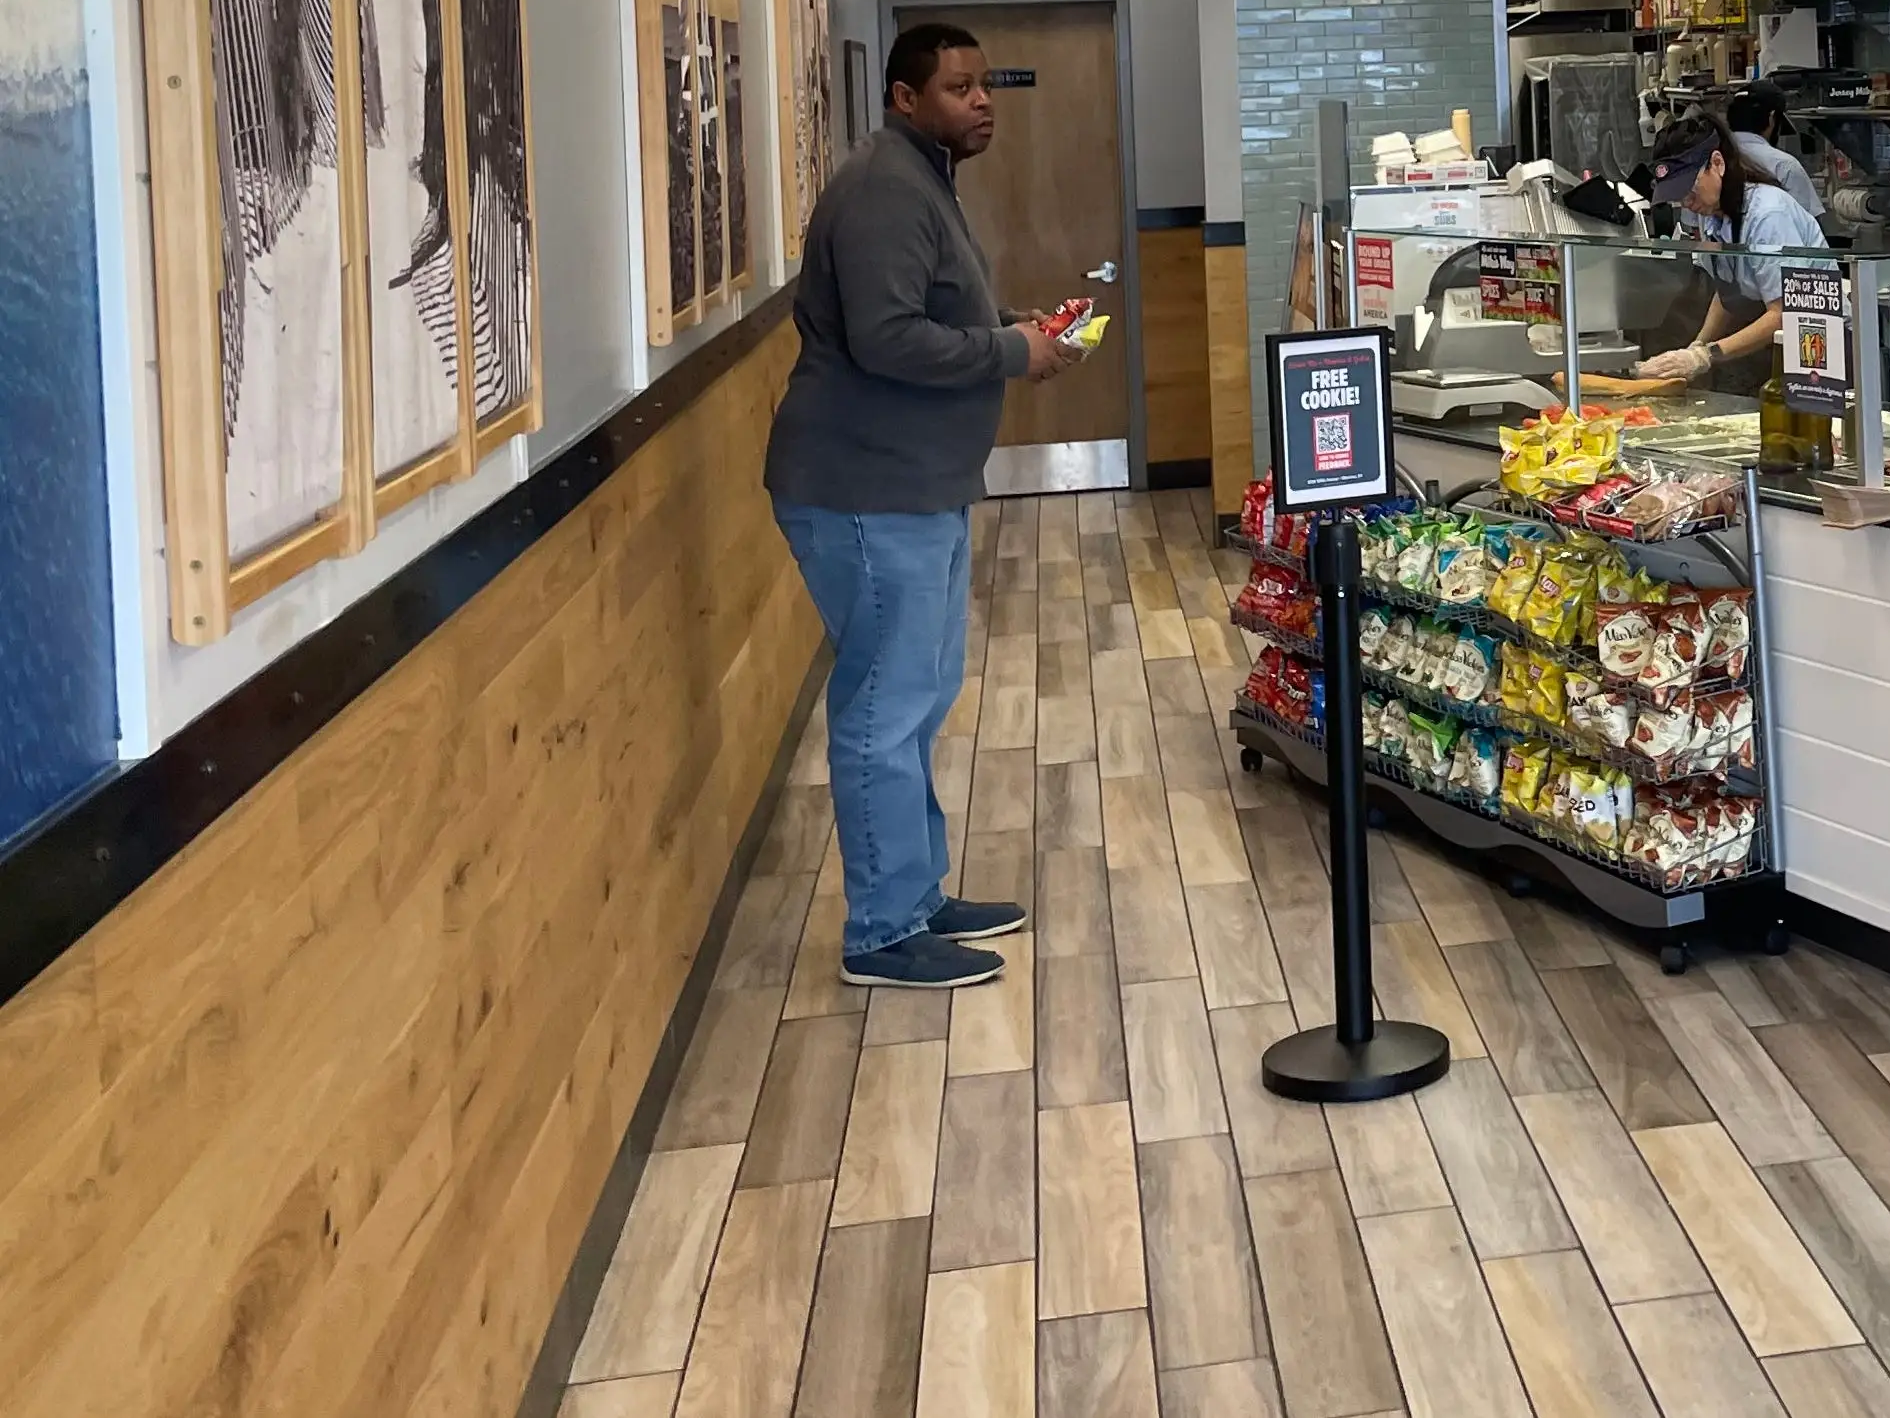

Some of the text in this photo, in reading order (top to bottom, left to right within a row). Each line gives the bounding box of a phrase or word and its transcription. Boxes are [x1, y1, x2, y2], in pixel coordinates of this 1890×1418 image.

[1784, 278, 1839, 296] 20% OF SALES
[1784, 292, 1840, 311] DONATED TO
[1363, 309, 1388, 320] AMERICA
[1311, 368, 1349, 390] FREE
[1301, 386, 1361, 411] COOKIE!
